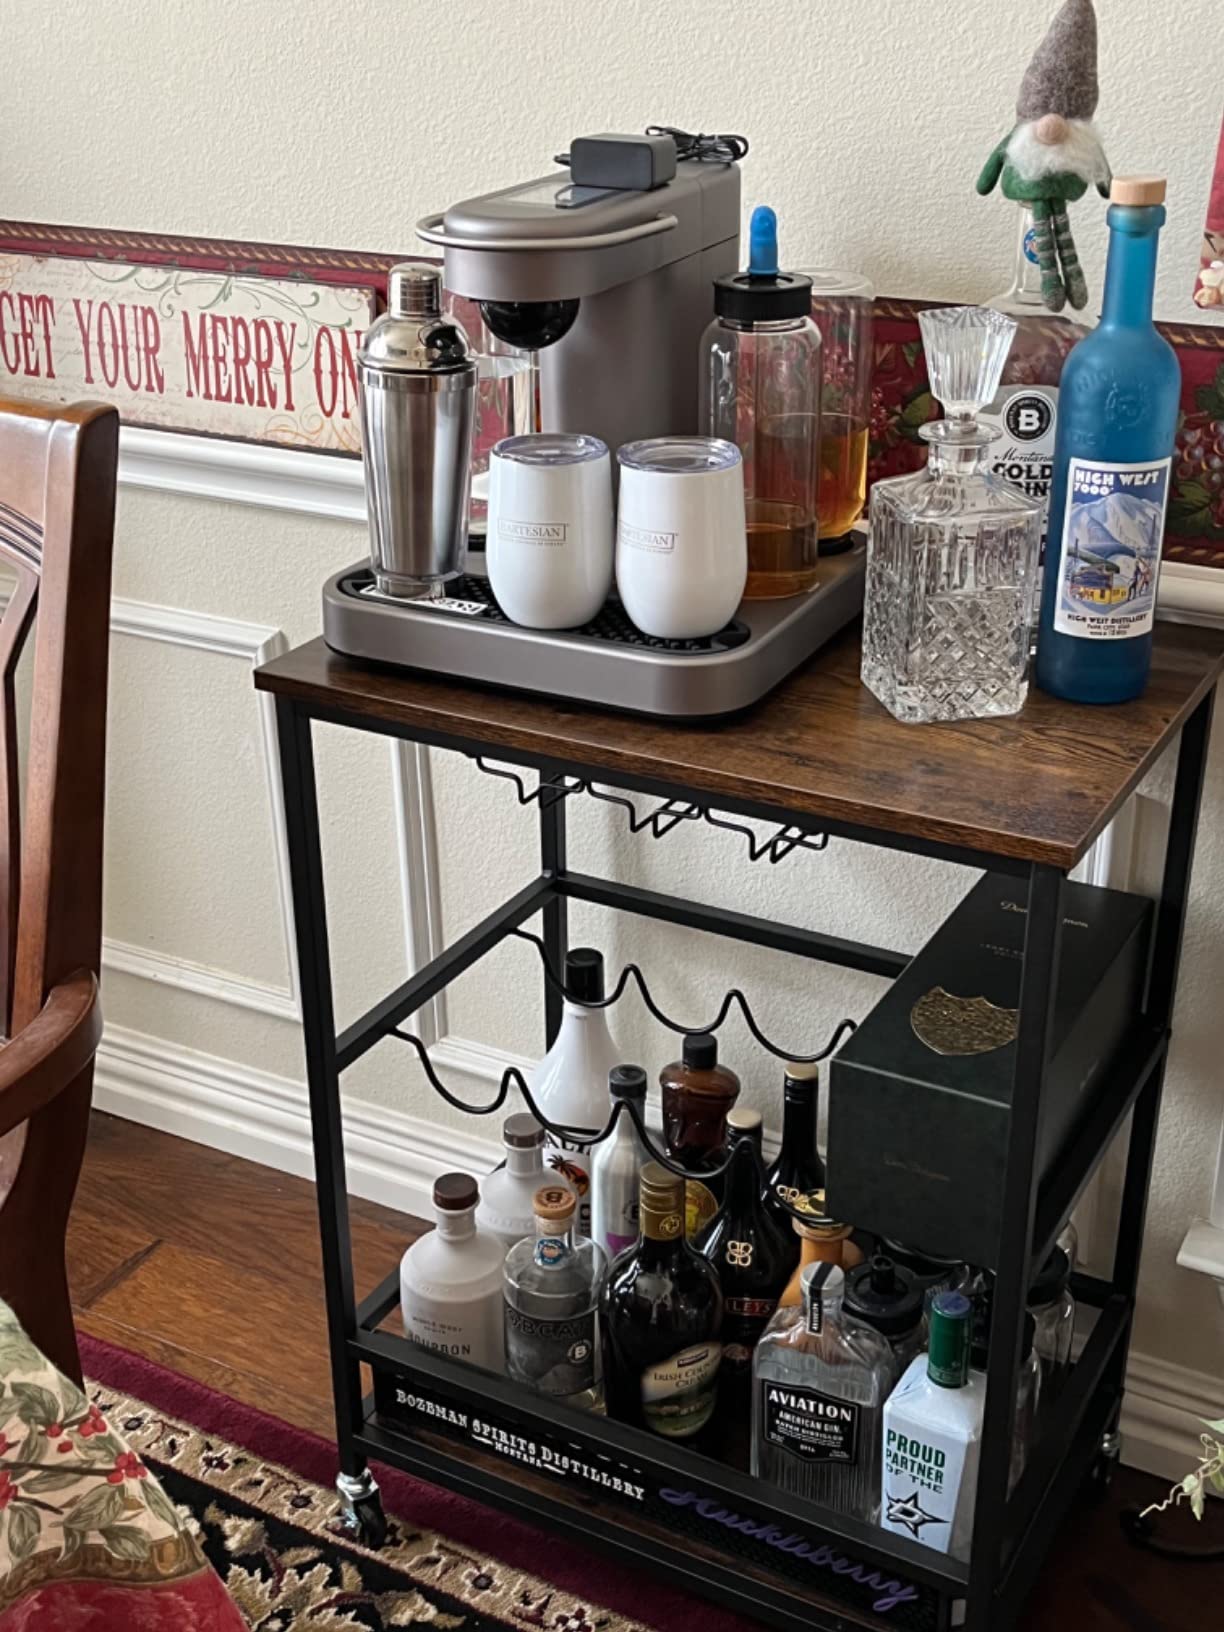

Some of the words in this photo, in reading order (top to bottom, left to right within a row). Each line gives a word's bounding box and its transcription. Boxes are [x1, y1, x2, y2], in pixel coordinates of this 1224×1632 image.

[0, 291, 56, 380] GET
[73, 298, 165, 395] YOUR
[181, 310, 297, 412] MERRY
[313, 325, 362, 419] ON
[1074, 469, 1114, 486] HIGH
[1119, 470, 1160, 487] WEST
[769, 1389, 852, 1422] AVIATION
[396, 1388, 468, 1429] BOZEMAN
[472, 1418, 536, 1456] SPIRITS
[540, 1446, 646, 1501] DISTILLERY
[887, 1428, 946, 1468] PROUD
[886, 1448, 944, 1485] PARTNER
[886, 1463, 904, 1477] OF
[908, 1473, 944, 1495] THE
